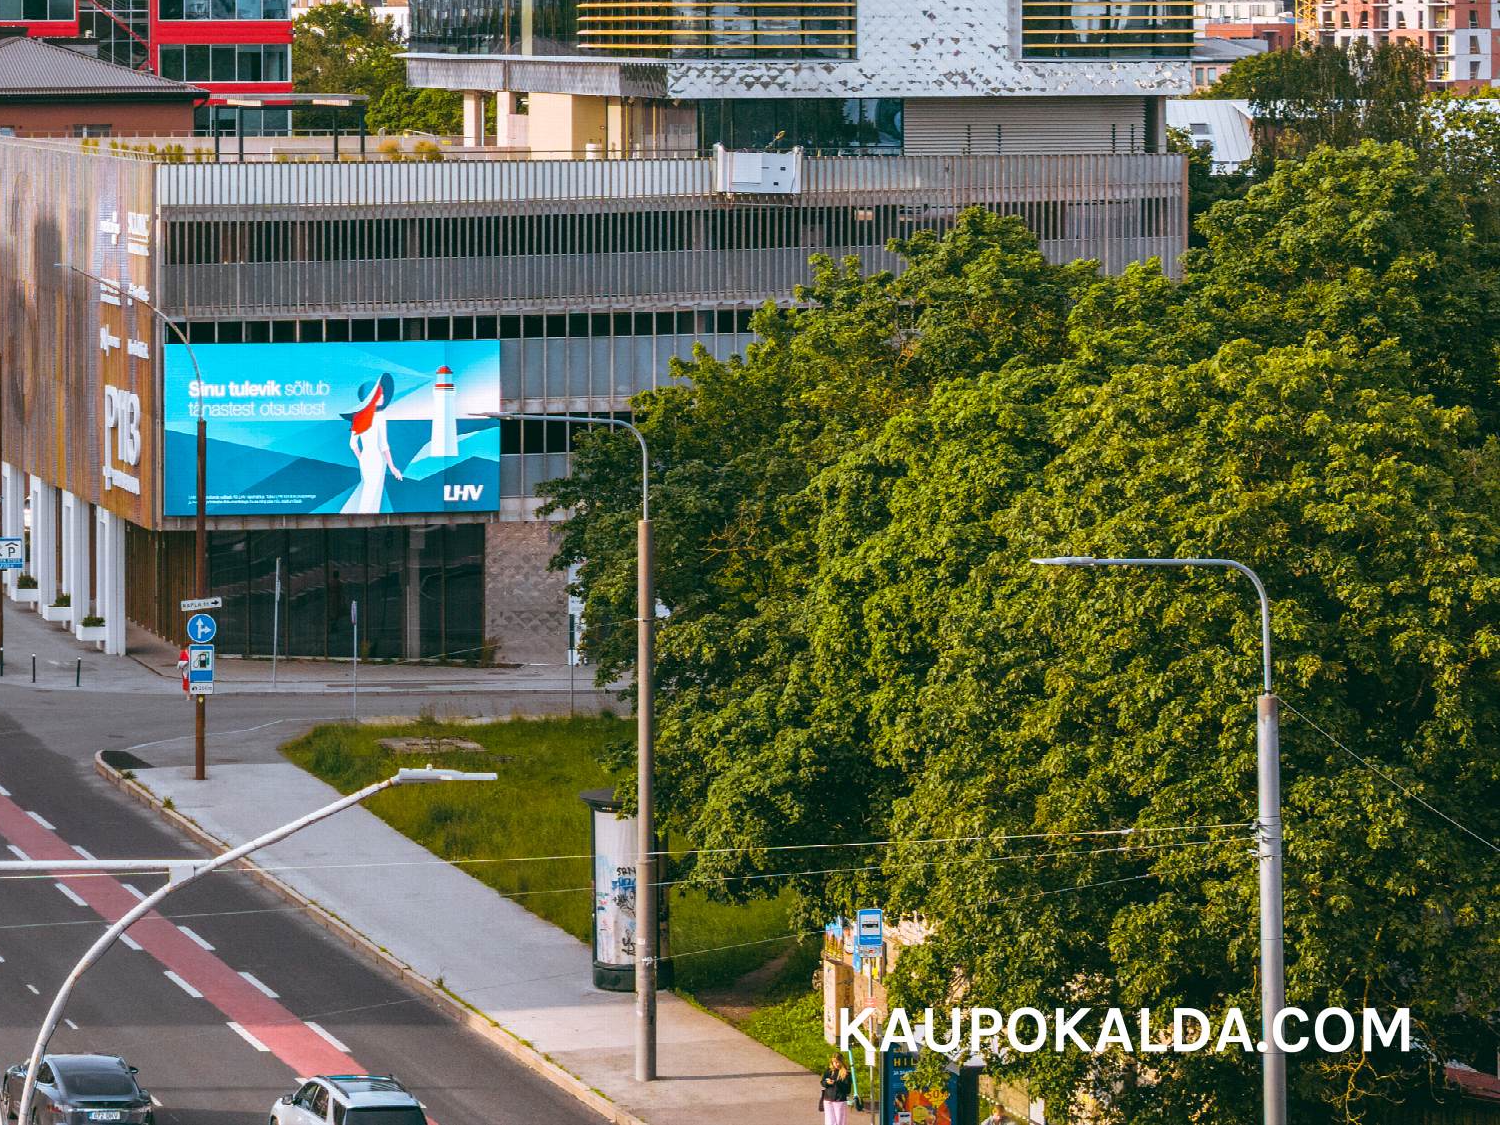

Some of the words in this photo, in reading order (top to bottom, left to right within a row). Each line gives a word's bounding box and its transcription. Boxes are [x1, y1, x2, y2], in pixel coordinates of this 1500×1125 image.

[187, 380, 226, 398] Sinu
[228, 380, 282, 398] tulevik
[283, 379, 331, 398] sõltub
[187, 401, 256, 417] tänastest
[259, 402, 326, 417] otsustest
[443, 484, 485, 502] LHV
